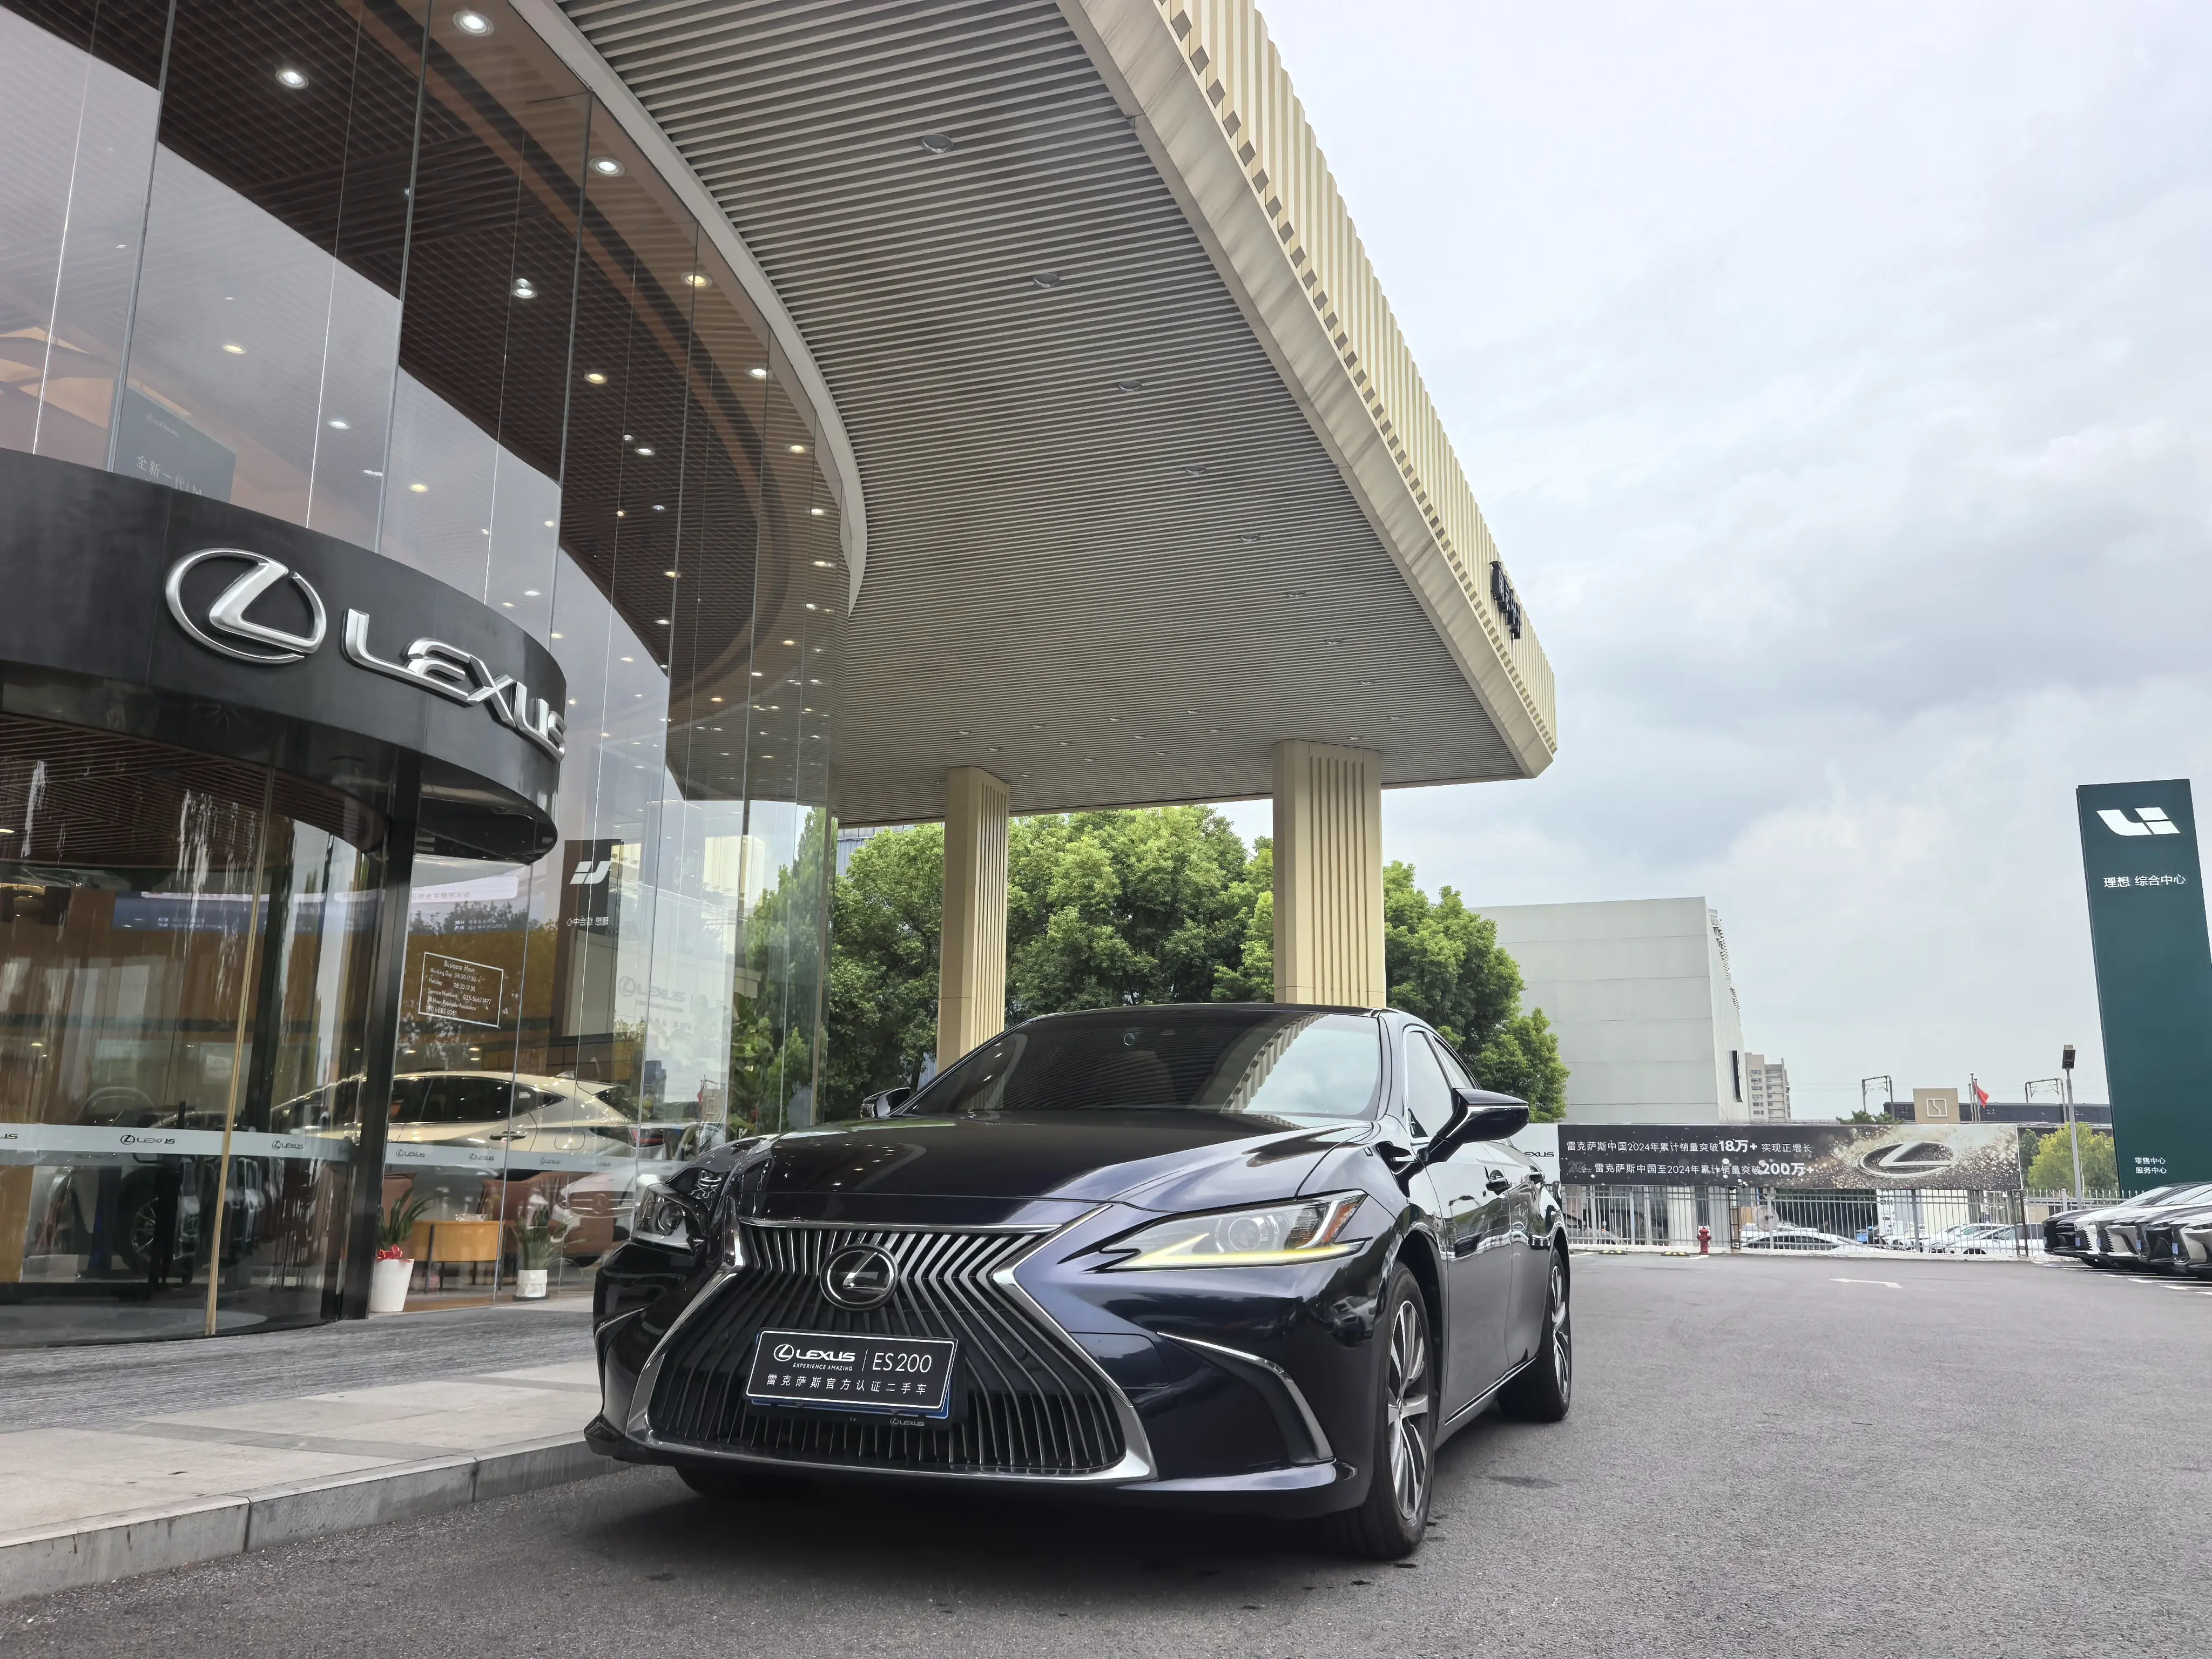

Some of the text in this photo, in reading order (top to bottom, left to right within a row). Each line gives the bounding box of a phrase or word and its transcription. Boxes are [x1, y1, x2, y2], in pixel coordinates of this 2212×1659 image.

[341, 608, 567, 762] LEXUS
[2103, 874, 2186, 888] 理想 综合中心
[1762, 1143, 1813, 1153] 实现正增长
[796, 1349, 932, 1373] LEXUS ES200
[767, 1373, 927, 1394] 雷克萨斯官方认证二手车
